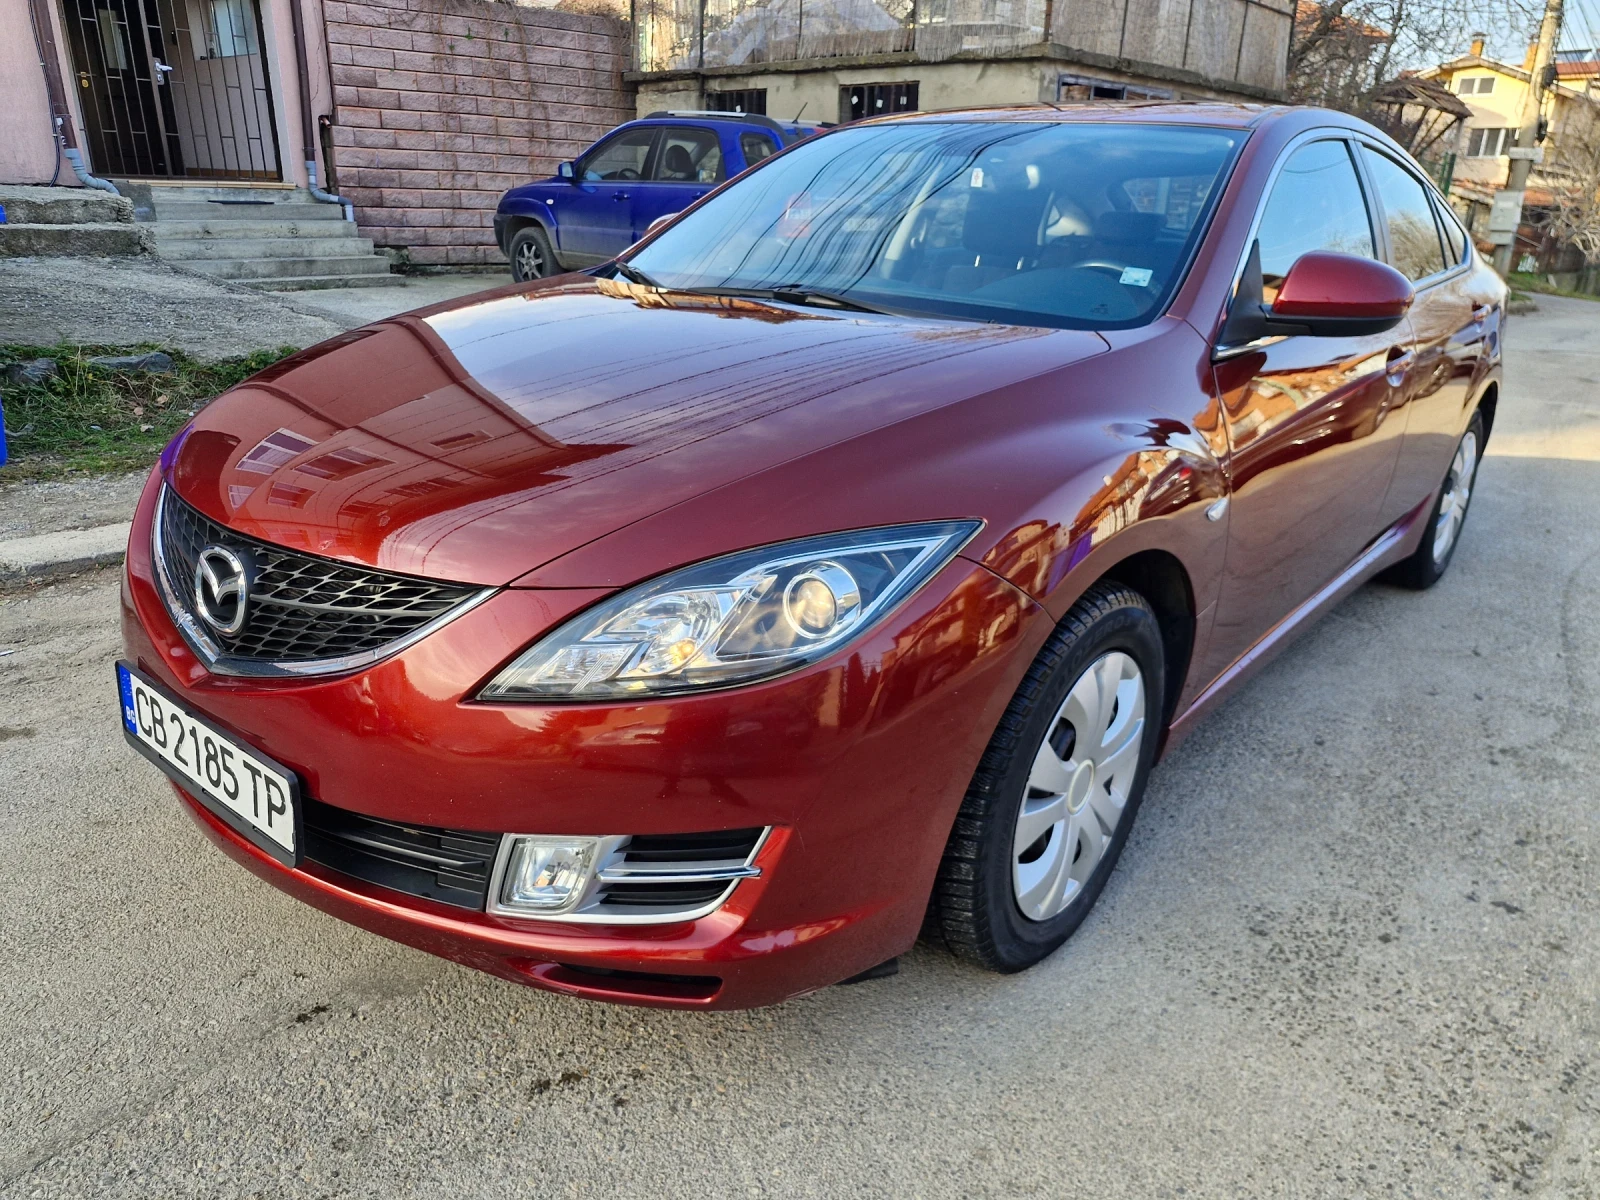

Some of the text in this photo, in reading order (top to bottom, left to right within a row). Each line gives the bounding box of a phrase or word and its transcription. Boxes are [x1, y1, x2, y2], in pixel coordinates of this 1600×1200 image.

[125, 705, 136, 724] BG
[135, 686, 287, 829] CB 2185 TP
